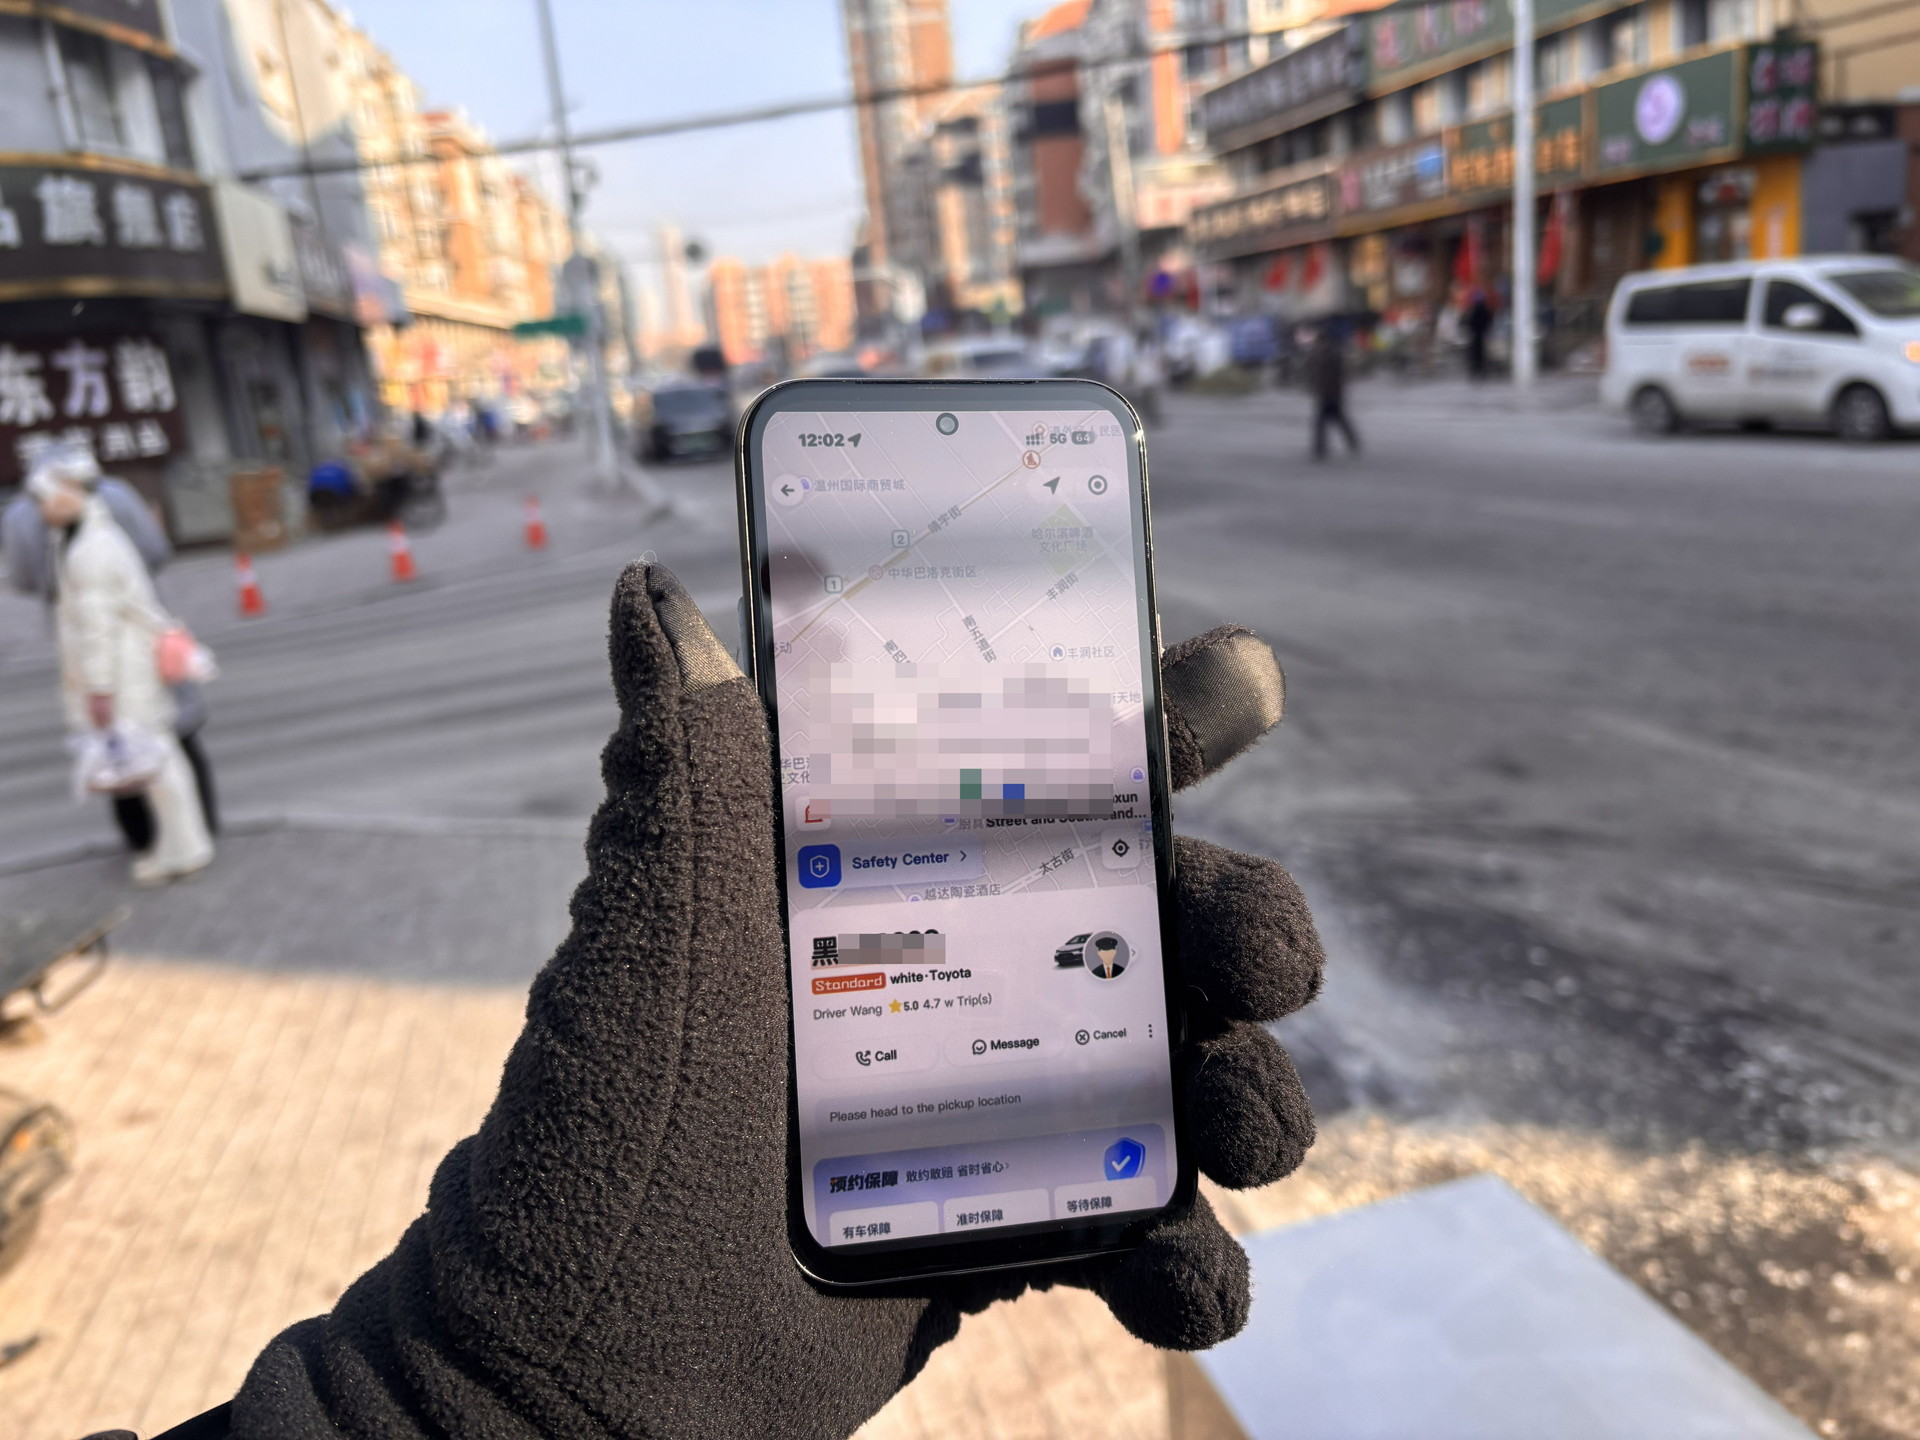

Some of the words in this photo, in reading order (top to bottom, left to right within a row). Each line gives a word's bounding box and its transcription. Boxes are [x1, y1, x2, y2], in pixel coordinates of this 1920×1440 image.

[0, 338, 178, 427] 东方
[798, 433, 845, 447] 12:02
[1050, 433, 1068, 444] 5G
[814, 479, 906, 492] 温州国际商贸城
[1031, 526, 1094, 540] 哈尔滨啤酒
[1040, 540, 1088, 553] 文化广场
[888, 565, 977, 580] 中华巴洛克街区
[1046, 571, 1079, 600] 丰润街
[962, 614, 997, 663] 南五道街
[883, 639, 911, 663] 南四
[1067, 645, 1115, 659] 丰润社区
[781, 757, 810, 770] 华巴
[1112, 793, 1139, 804] xun
[852, 854, 898, 869] Safety
[902, 852, 950, 866] Center
[1039, 848, 1075, 876] 太古街
[924, 883, 1001, 901] 越达陶瓷酒店
[815, 975, 883, 992] Standard
[813, 1008, 847, 1020] Driver
[850, 1005, 882, 1017] Wang
[903, 1001, 919, 1012] 5.0
[923, 998, 940, 1010] 4.7
[944, 999, 954, 1007] w
[957, 993, 992, 1007] Trip(s)
[1093, 1028, 1127, 1041] Cancel
[990, 1036, 1040, 1051] Message
[875, 1050, 897, 1062] Call
[829, 1108, 867, 1122] Please
[870, 1105, 898, 1119] head
[901, 1106, 914, 1116] to
[916, 1102, 935, 1114] the
[937, 1098, 975, 1113] pickup
[977, 1093, 1022, 1107] location
[829, 1170, 899, 1193] 预约保障
[905, 1165, 954, 1183] 敢约敢赔
[956, 1161, 1005, 1178] 省时省心
[1066, 1196, 1113, 1213] 等待保障
[955, 1209, 1004, 1226] 准时保障
[842, 1221, 892, 1239] 有车保障
